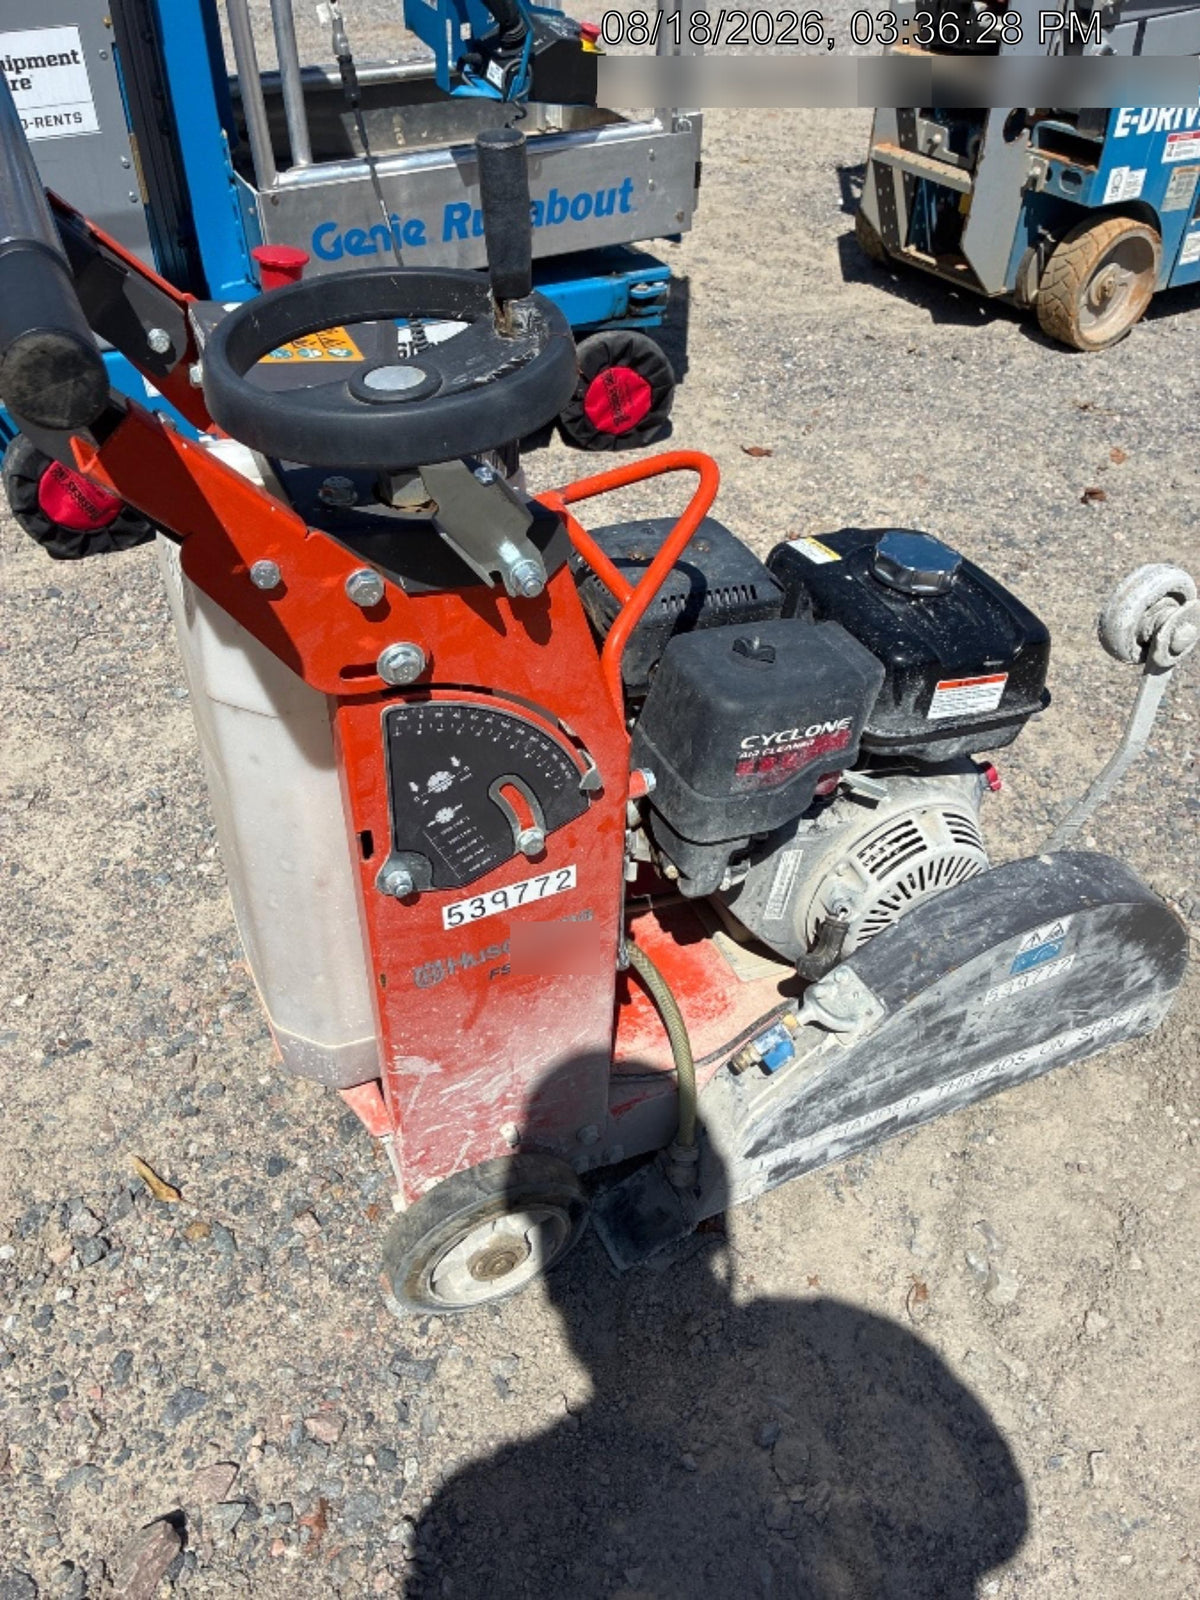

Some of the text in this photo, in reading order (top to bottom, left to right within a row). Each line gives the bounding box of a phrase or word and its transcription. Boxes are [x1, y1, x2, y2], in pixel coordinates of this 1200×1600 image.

[1113, 107, 1200, 138] E-DRIV
[312, 176, 634, 261] Genie Ruabout
[740, 716, 853, 750] CYCLONE
[446, 869, 572, 928] 539772
